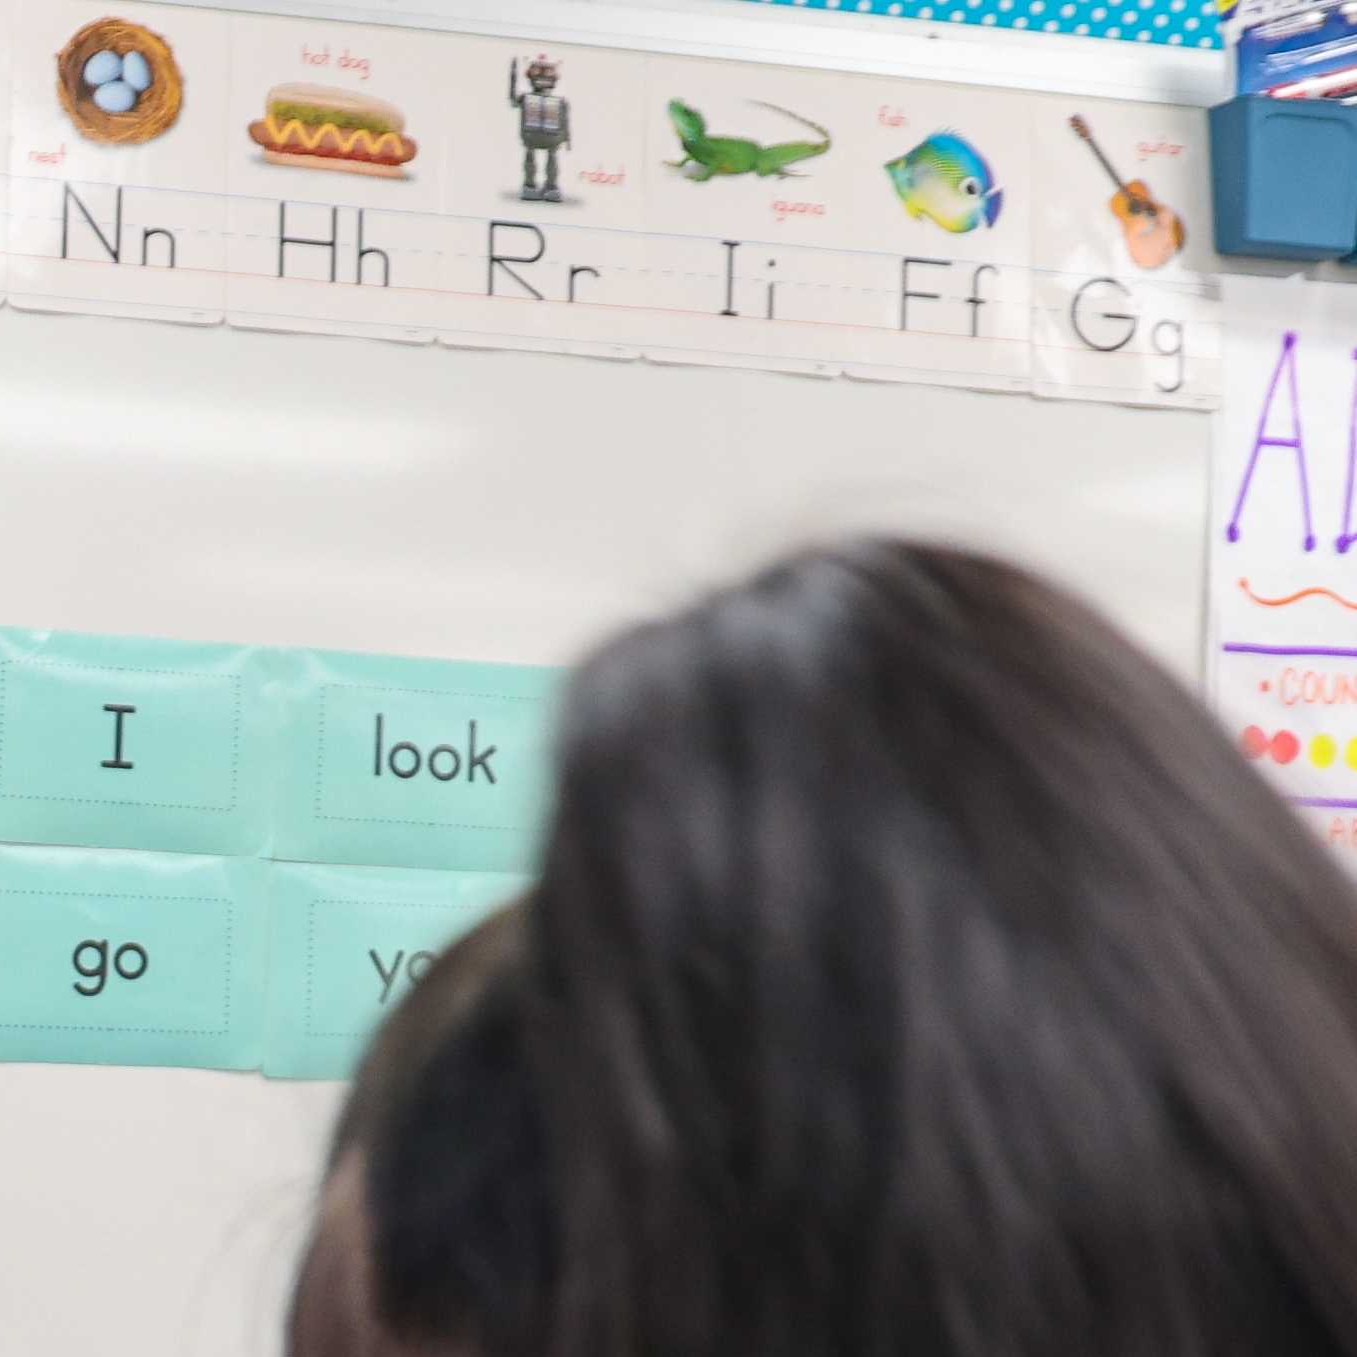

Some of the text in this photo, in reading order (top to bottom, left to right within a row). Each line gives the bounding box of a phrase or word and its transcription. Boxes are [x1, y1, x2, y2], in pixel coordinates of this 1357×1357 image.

[60, 185, 176, 269] Nn
[277, 201, 390, 288] Hh
[487, 220, 600, 303] Rr
[718, 239, 776, 320] Ii
[901, 256, 999, 338] Ff
[1070, 277, 1182, 392] Gg
[100, 704, 136, 770] I
[373, 713, 496, 785] look
[72, 939, 148, 997] go
